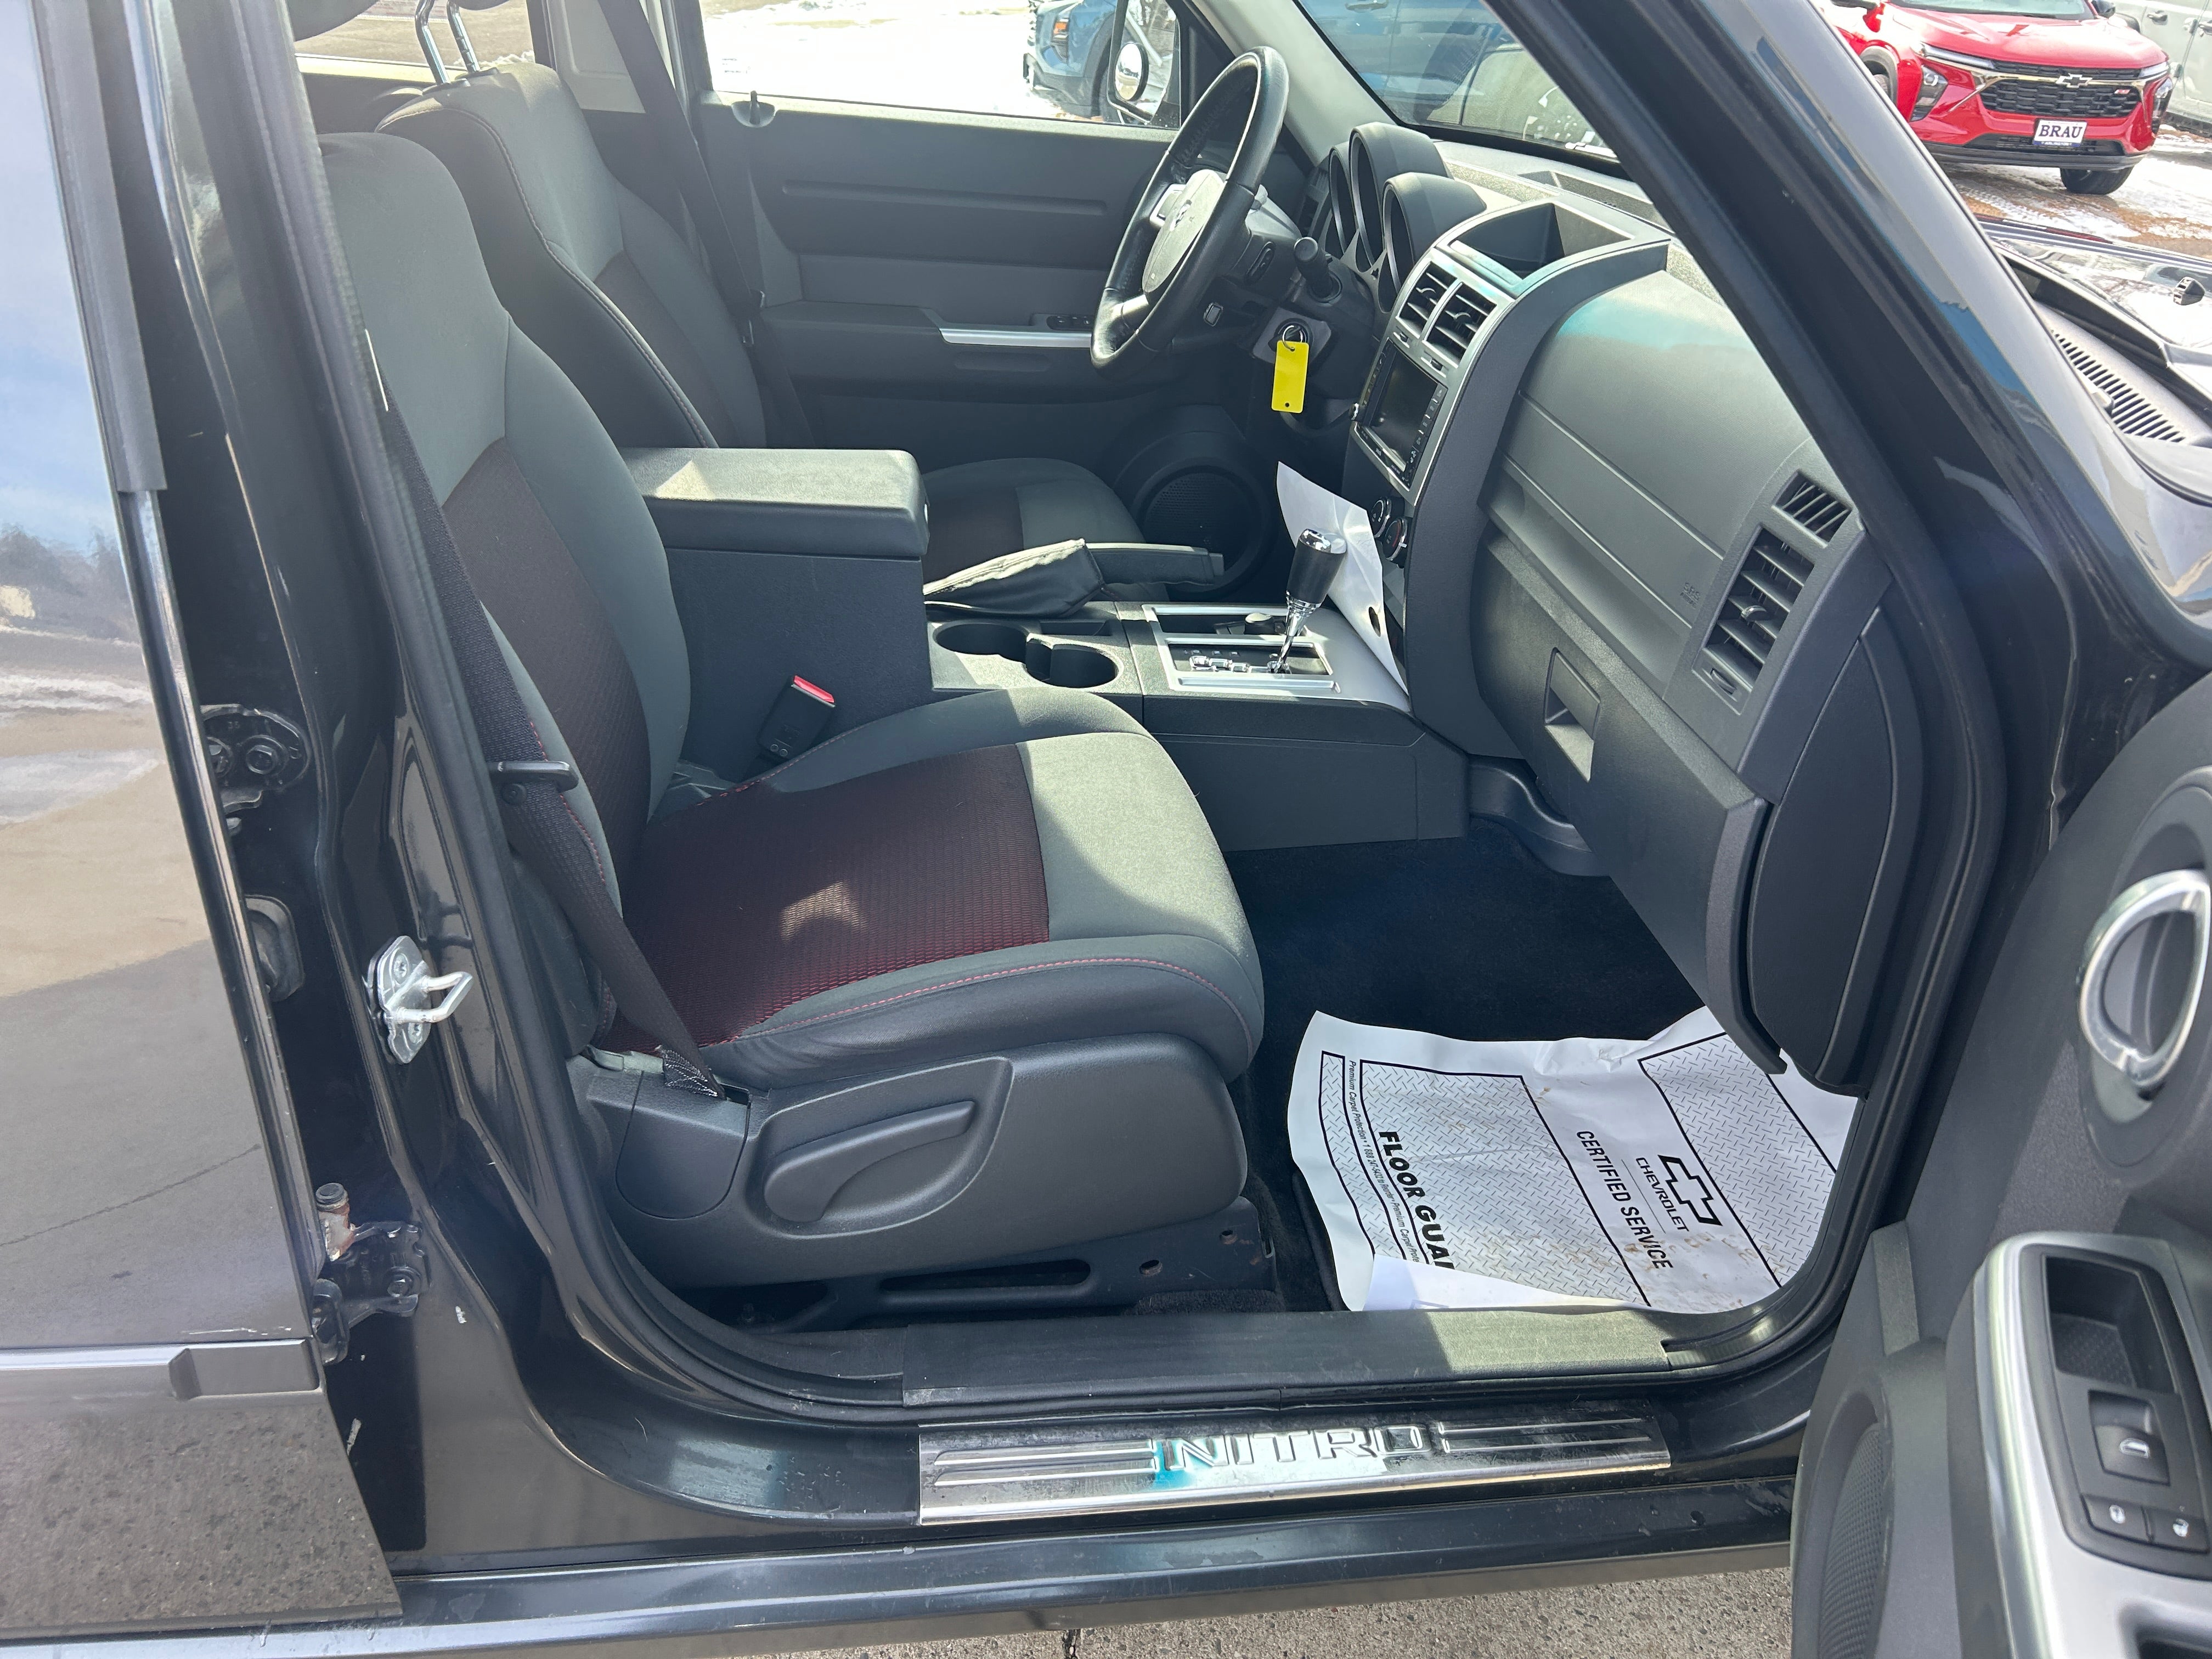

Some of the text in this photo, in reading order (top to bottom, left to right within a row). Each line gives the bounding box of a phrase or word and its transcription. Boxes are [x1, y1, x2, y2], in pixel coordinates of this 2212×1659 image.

[2038, 125, 2083, 138] BRAU
[1348, 1092, 1359, 1112] Carpet
[1352, 1113, 1367, 1139] Protection
[1364, 1149, 1375, 1159] 888
[1379, 1132, 1425, 1198] FLOOR
[1576, 1131, 1673, 1269] CERTIFIED SERVICE
[1635, 1157, 1689, 1232] CHEVROLET
[1391, 1202, 1406, 1227] Premium
[1400, 1229, 1414, 1248] Carpet
[1408, 1247, 1420, 1262] Prote
[1162, 1425, 1431, 1470] NITRO
